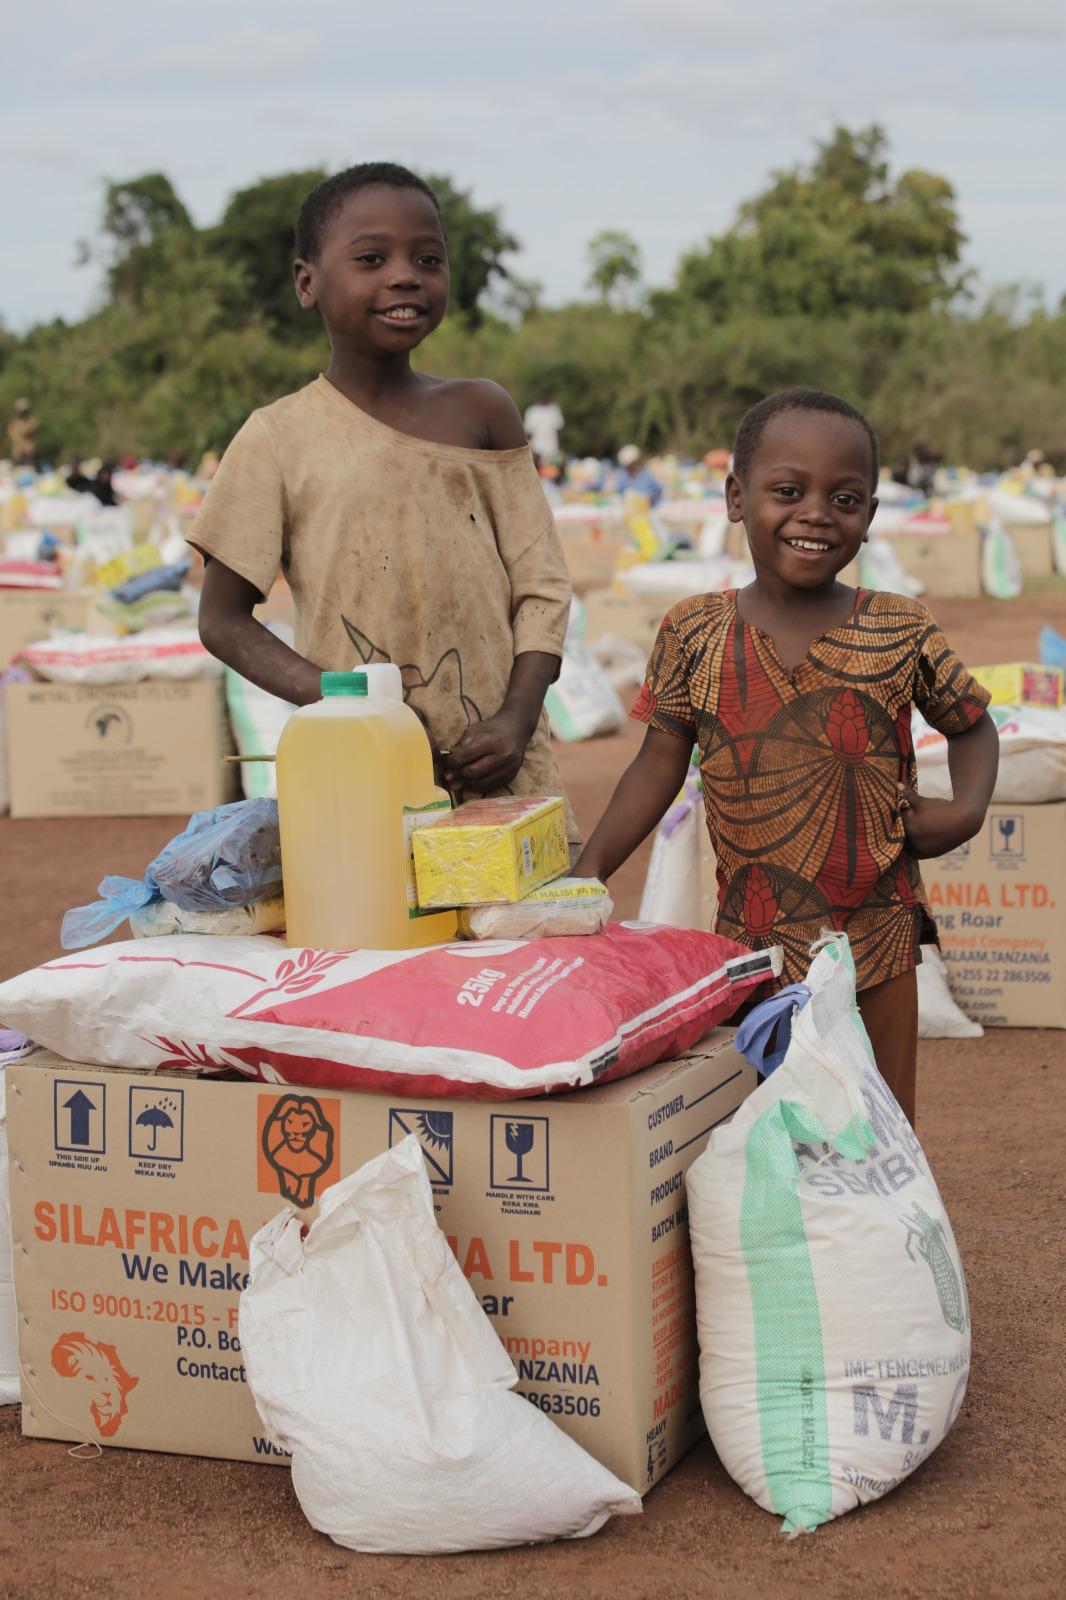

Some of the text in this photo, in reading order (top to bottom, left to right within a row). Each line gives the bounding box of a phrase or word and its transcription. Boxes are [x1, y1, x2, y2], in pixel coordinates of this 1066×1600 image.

[928, 883, 1057, 908] ANIA LTD.
[933, 911, 1003, 931] ng Roar
[457, 968, 506, 1008] 25kg
[648, 1094, 684, 1130] CUSTOMER
[56, 1153, 72, 1161] THIS
[138, 1161, 156, 1169] KEEP
[649, 1140, 674, 1169] BRAND
[134, 1168, 176, 1179] WEKA KAVU
[650, 1170, 683, 1206] PRODUCT
[652, 1213, 674, 1242] BATCH
[33, 1201, 249, 1260] SILAFRICA
[509, 1239, 608, 1287] LTD.
[121, 1252, 169, 1284] We
[477, 1293, 514, 1316] ar
[51, 1288, 86, 1313] ISO
[93, 1293, 206, 1326] 9001:2015
[499, 1335, 591, 1364] mpany
[177, 1326, 600, 1386] P.O. Bo NZANIA
[177, 1356, 601, 1418] Contact 863506
[646, 1417, 667, 1445] HEAVY
